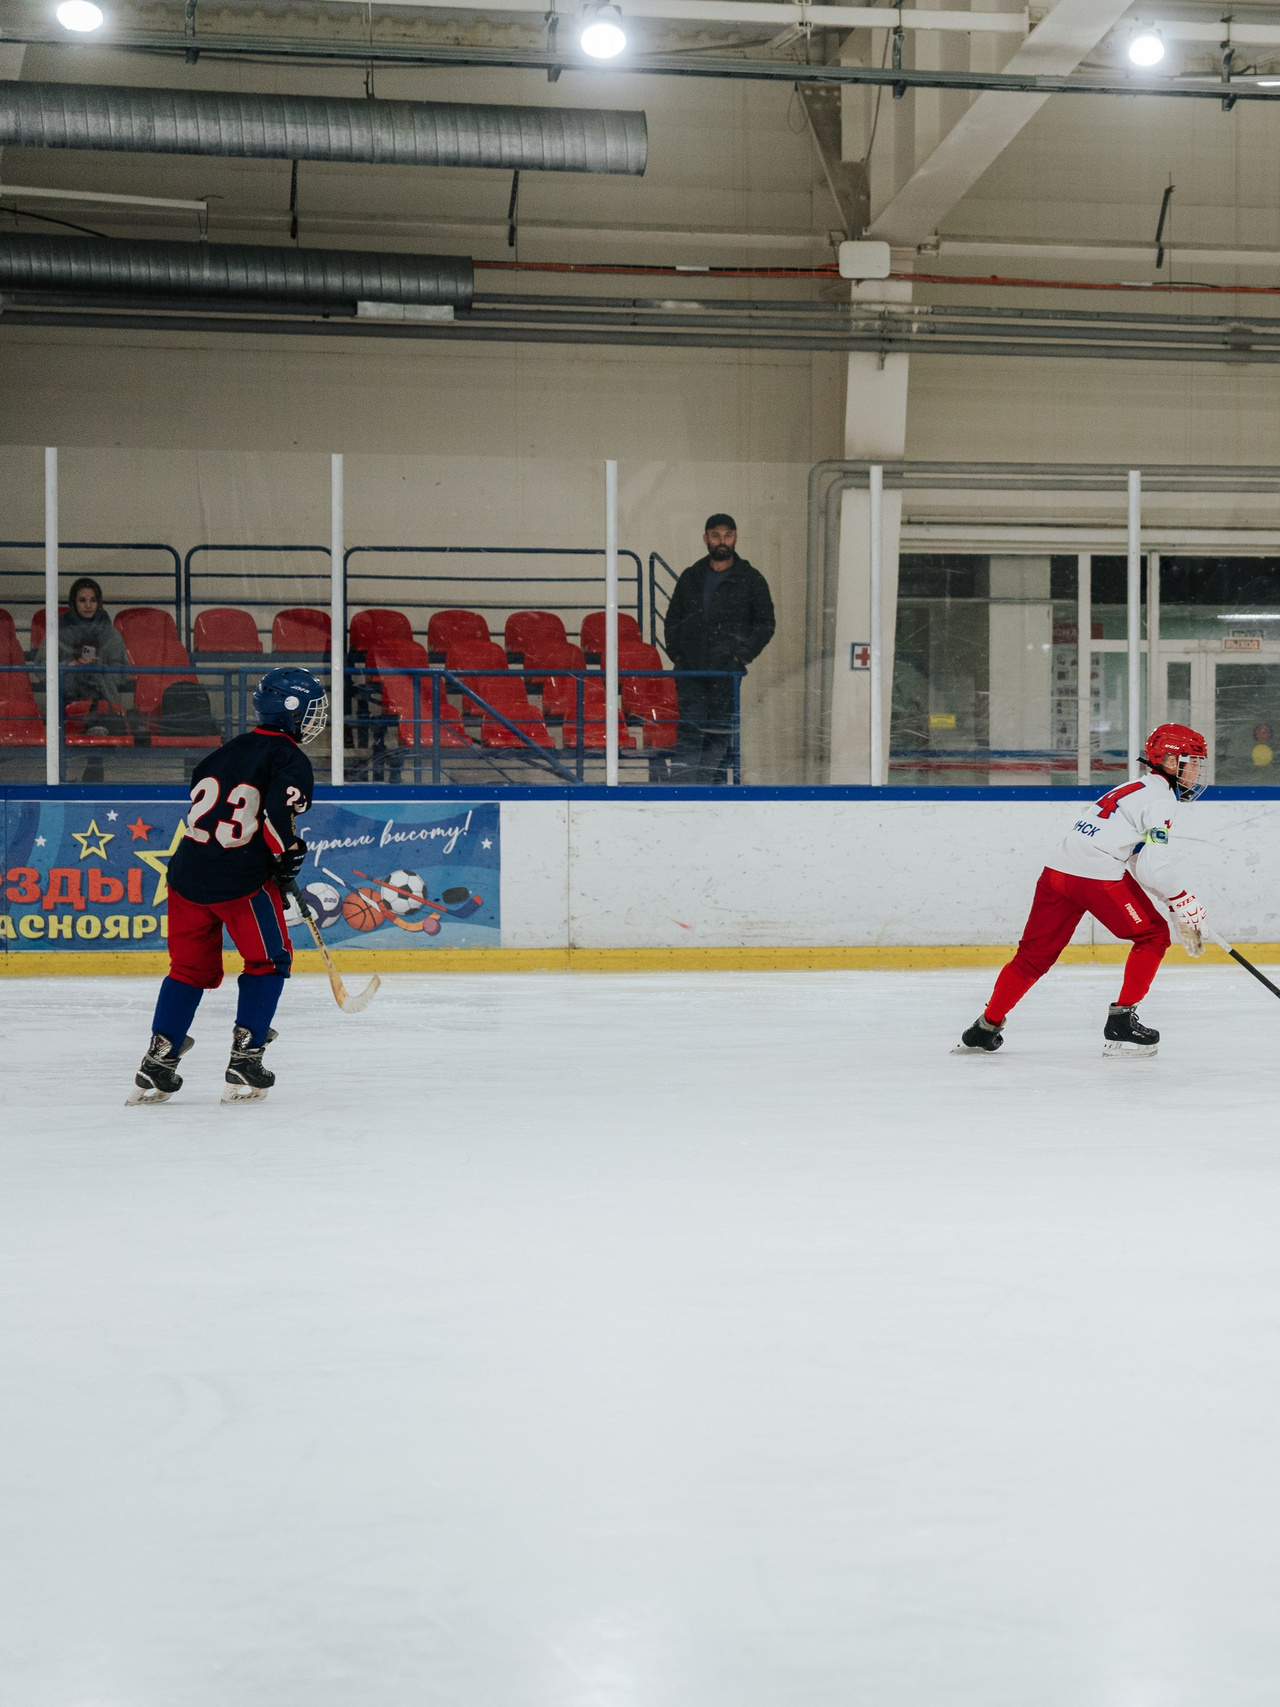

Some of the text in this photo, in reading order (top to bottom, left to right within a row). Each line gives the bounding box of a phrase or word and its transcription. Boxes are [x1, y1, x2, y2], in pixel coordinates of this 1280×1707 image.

[184, 775, 261, 850] 23
[1095, 781, 1147, 820] 4
[379, 809, 473, 855] высоту!
[0, 866, 144, 911] ЗДЫ
